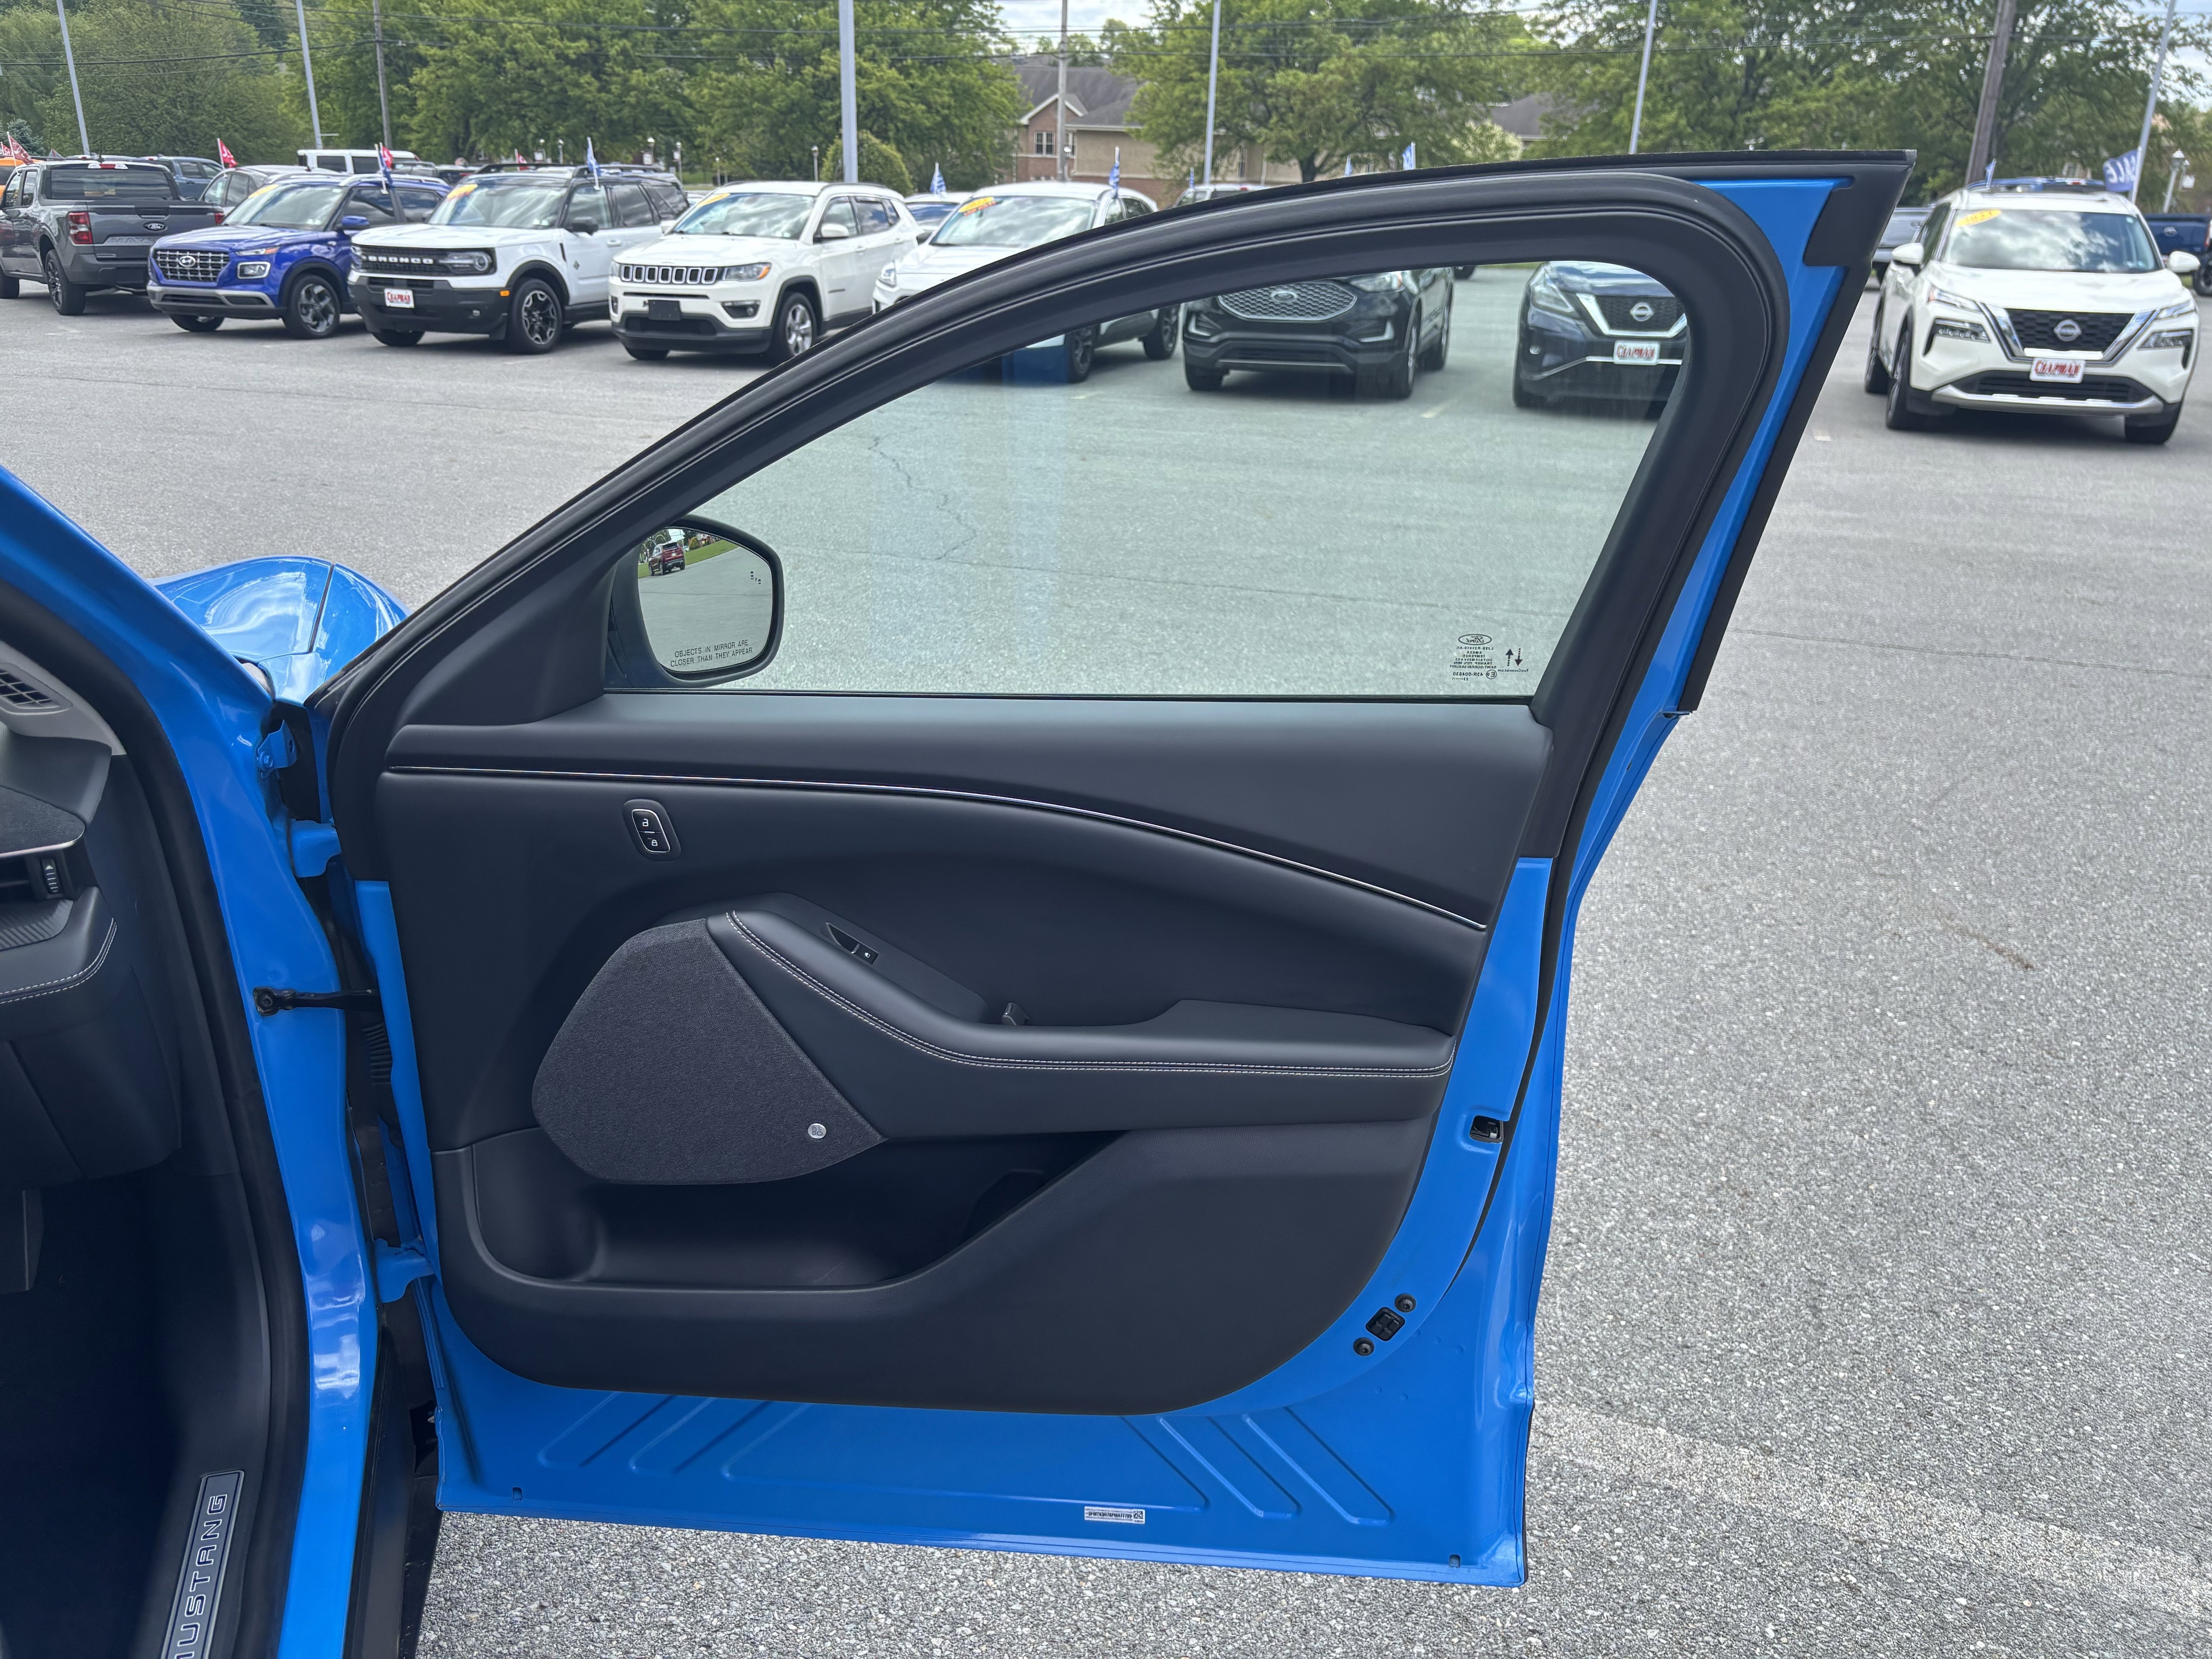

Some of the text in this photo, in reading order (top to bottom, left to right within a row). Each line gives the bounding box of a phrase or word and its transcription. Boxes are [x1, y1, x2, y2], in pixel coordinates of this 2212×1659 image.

[368, 255, 434, 264] BRONCO
[2034, 360, 2081, 376] CHAPMAN
[670, 647, 753, 667] CLOSER THAN THEY APPEAR
[674, 647, 702, 658] OBJECTS
[714, 642, 736, 651] MIRROR
